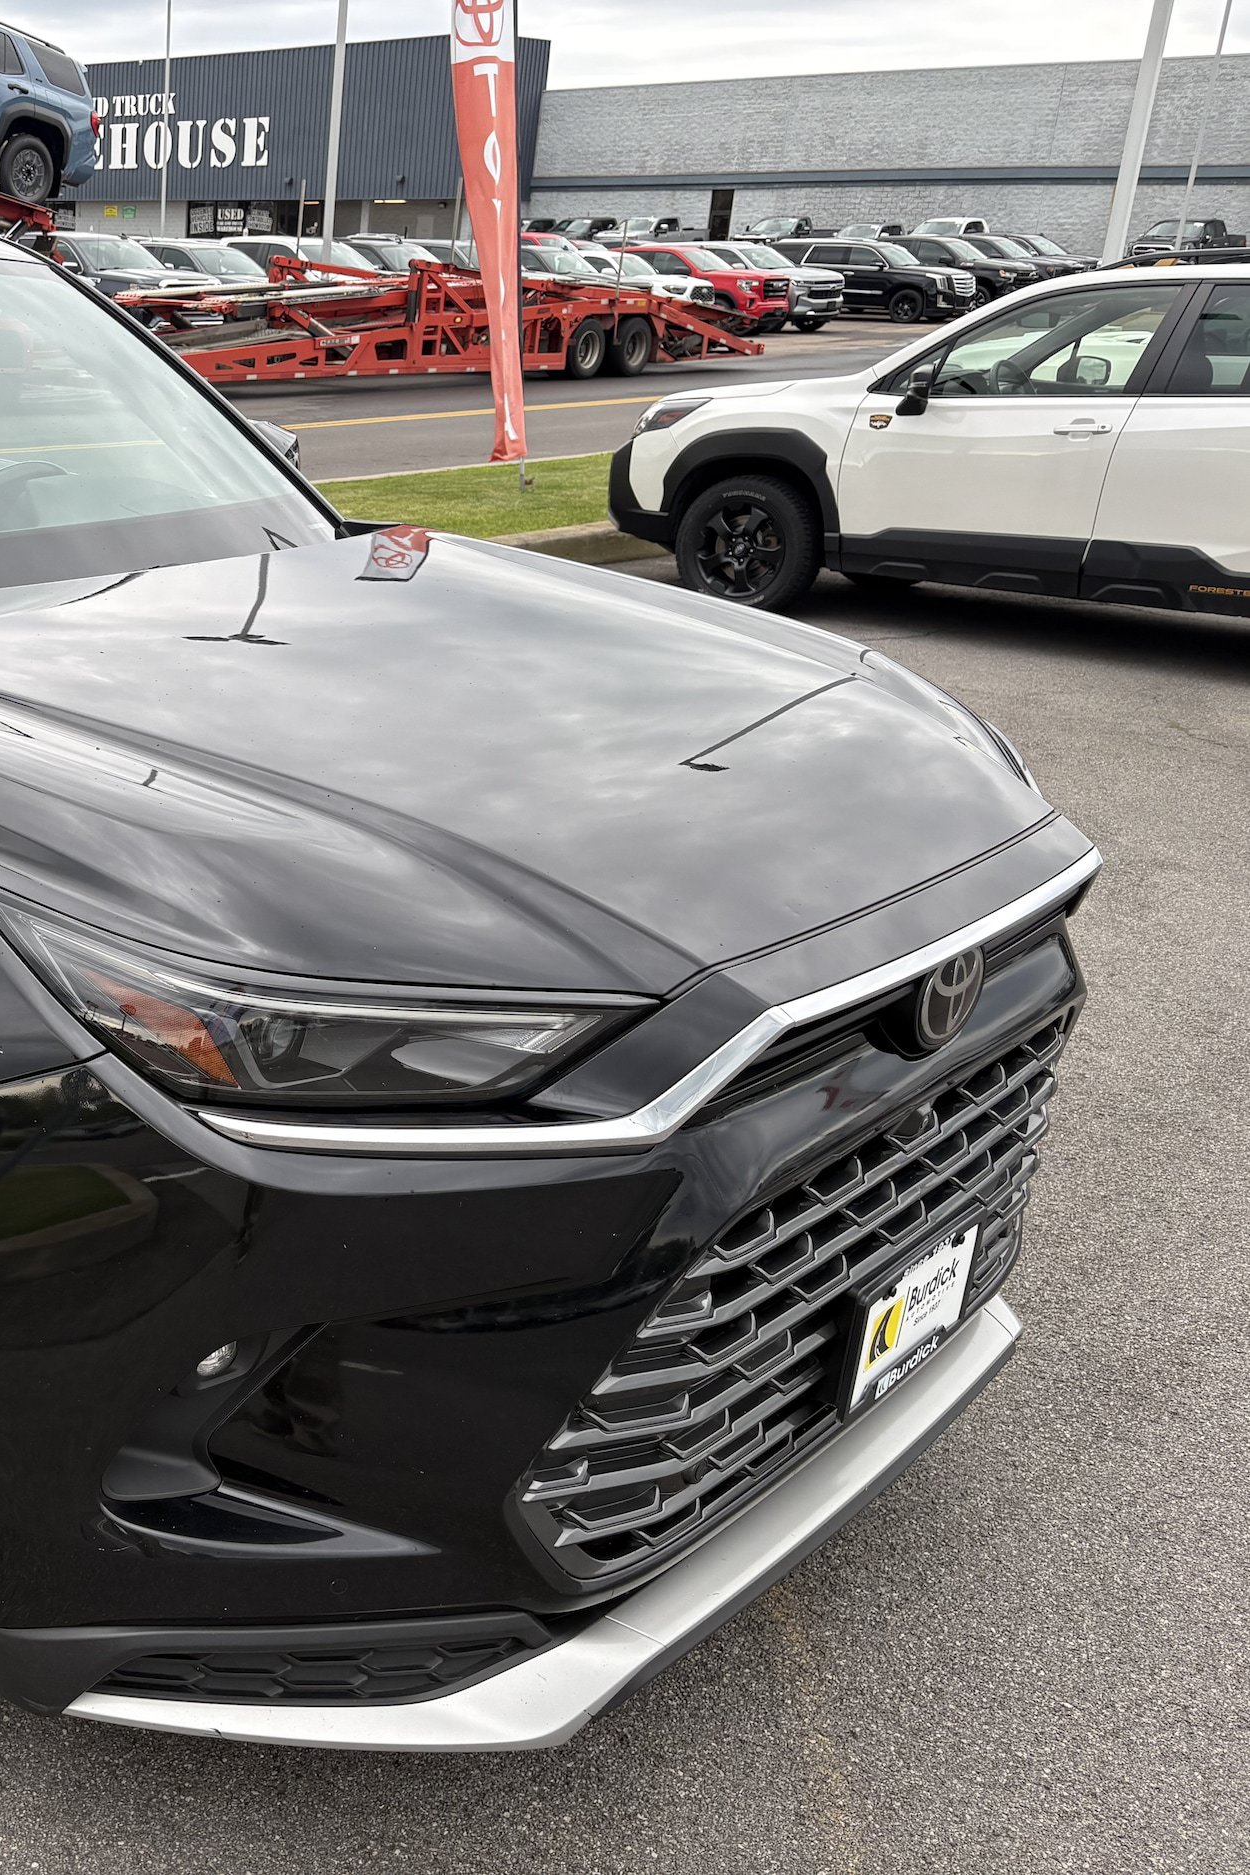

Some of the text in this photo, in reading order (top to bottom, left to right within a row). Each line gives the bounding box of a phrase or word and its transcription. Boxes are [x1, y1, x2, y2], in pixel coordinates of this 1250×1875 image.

[113, 93, 176, 117] TRUCK
[217, 208, 244, 220] USED
[190, 221, 214, 232] INSIDE
[908, 1257, 960, 1313] Burdick
[888, 1335, 940, 1388] Burdick
